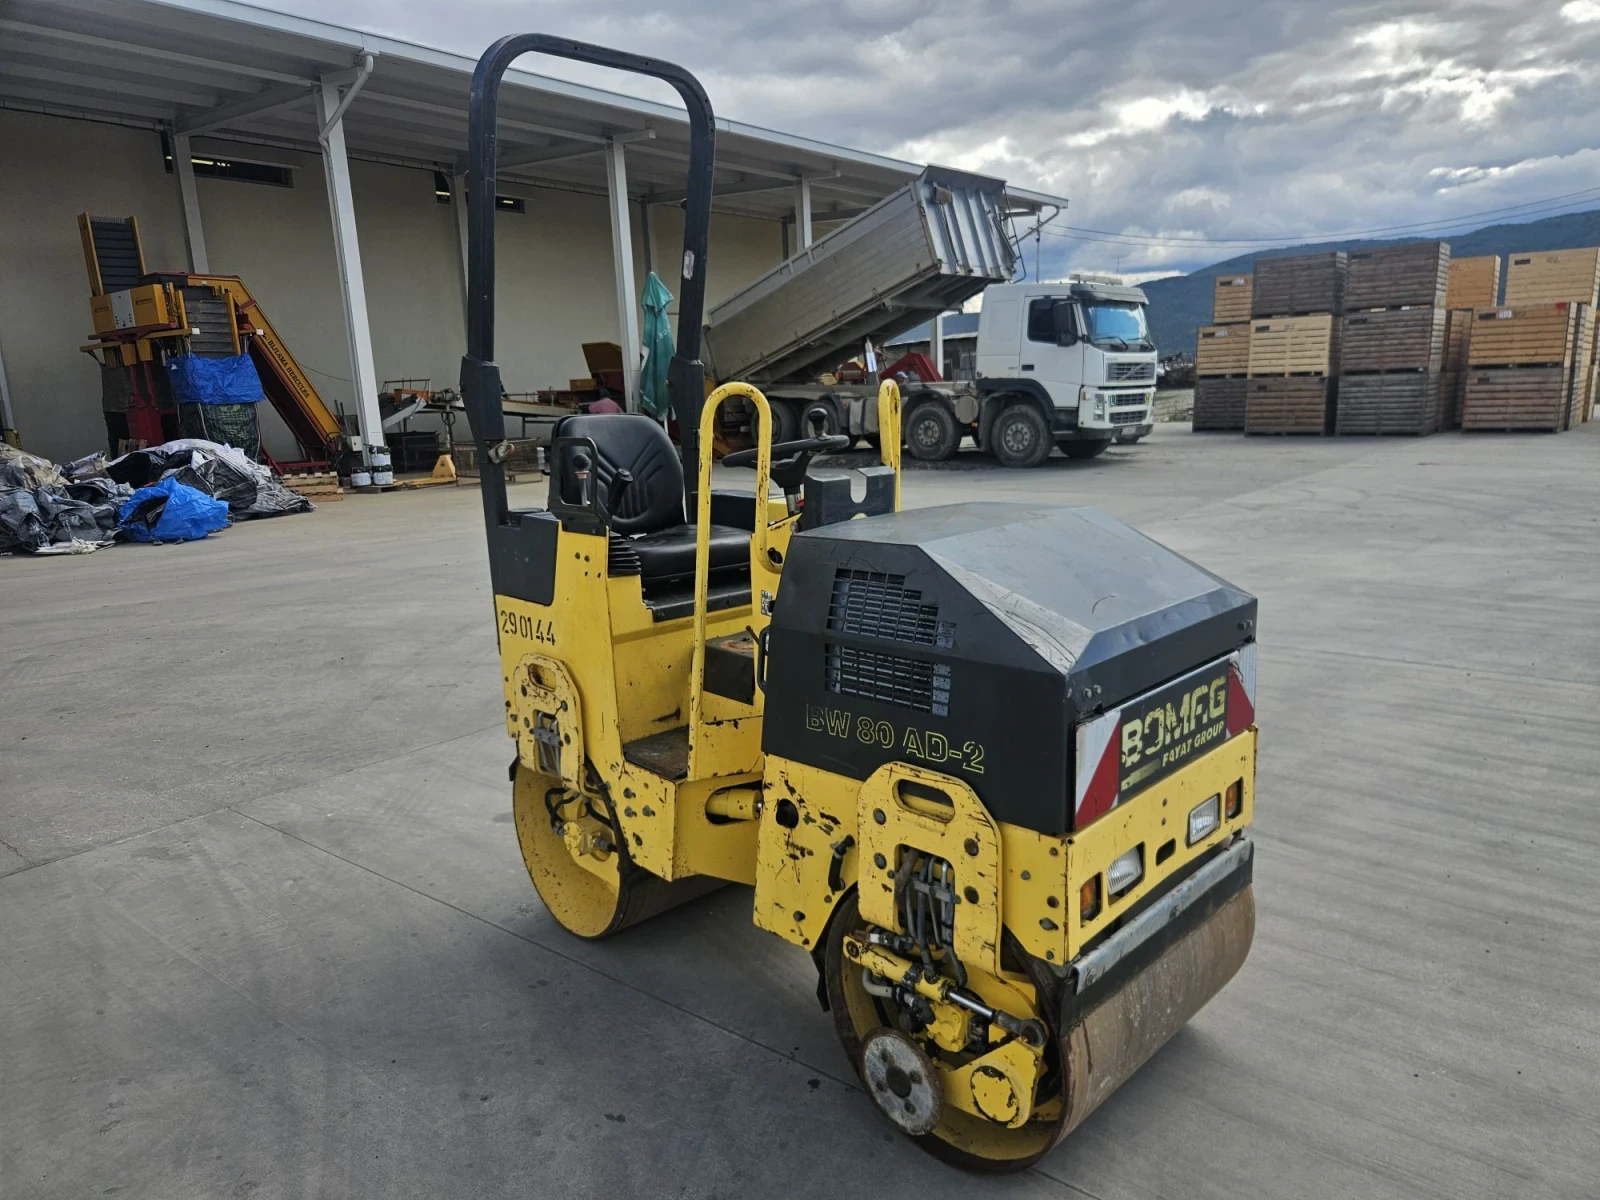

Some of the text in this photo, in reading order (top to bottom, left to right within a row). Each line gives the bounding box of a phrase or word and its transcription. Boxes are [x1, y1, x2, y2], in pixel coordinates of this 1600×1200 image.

[286, 366, 310, 399] HERCULES
[500, 610, 555, 646] 290144
[806, 703, 985, 774] BW 80 AD-2
[1162, 720, 1224, 767] FAYAT GROUP
